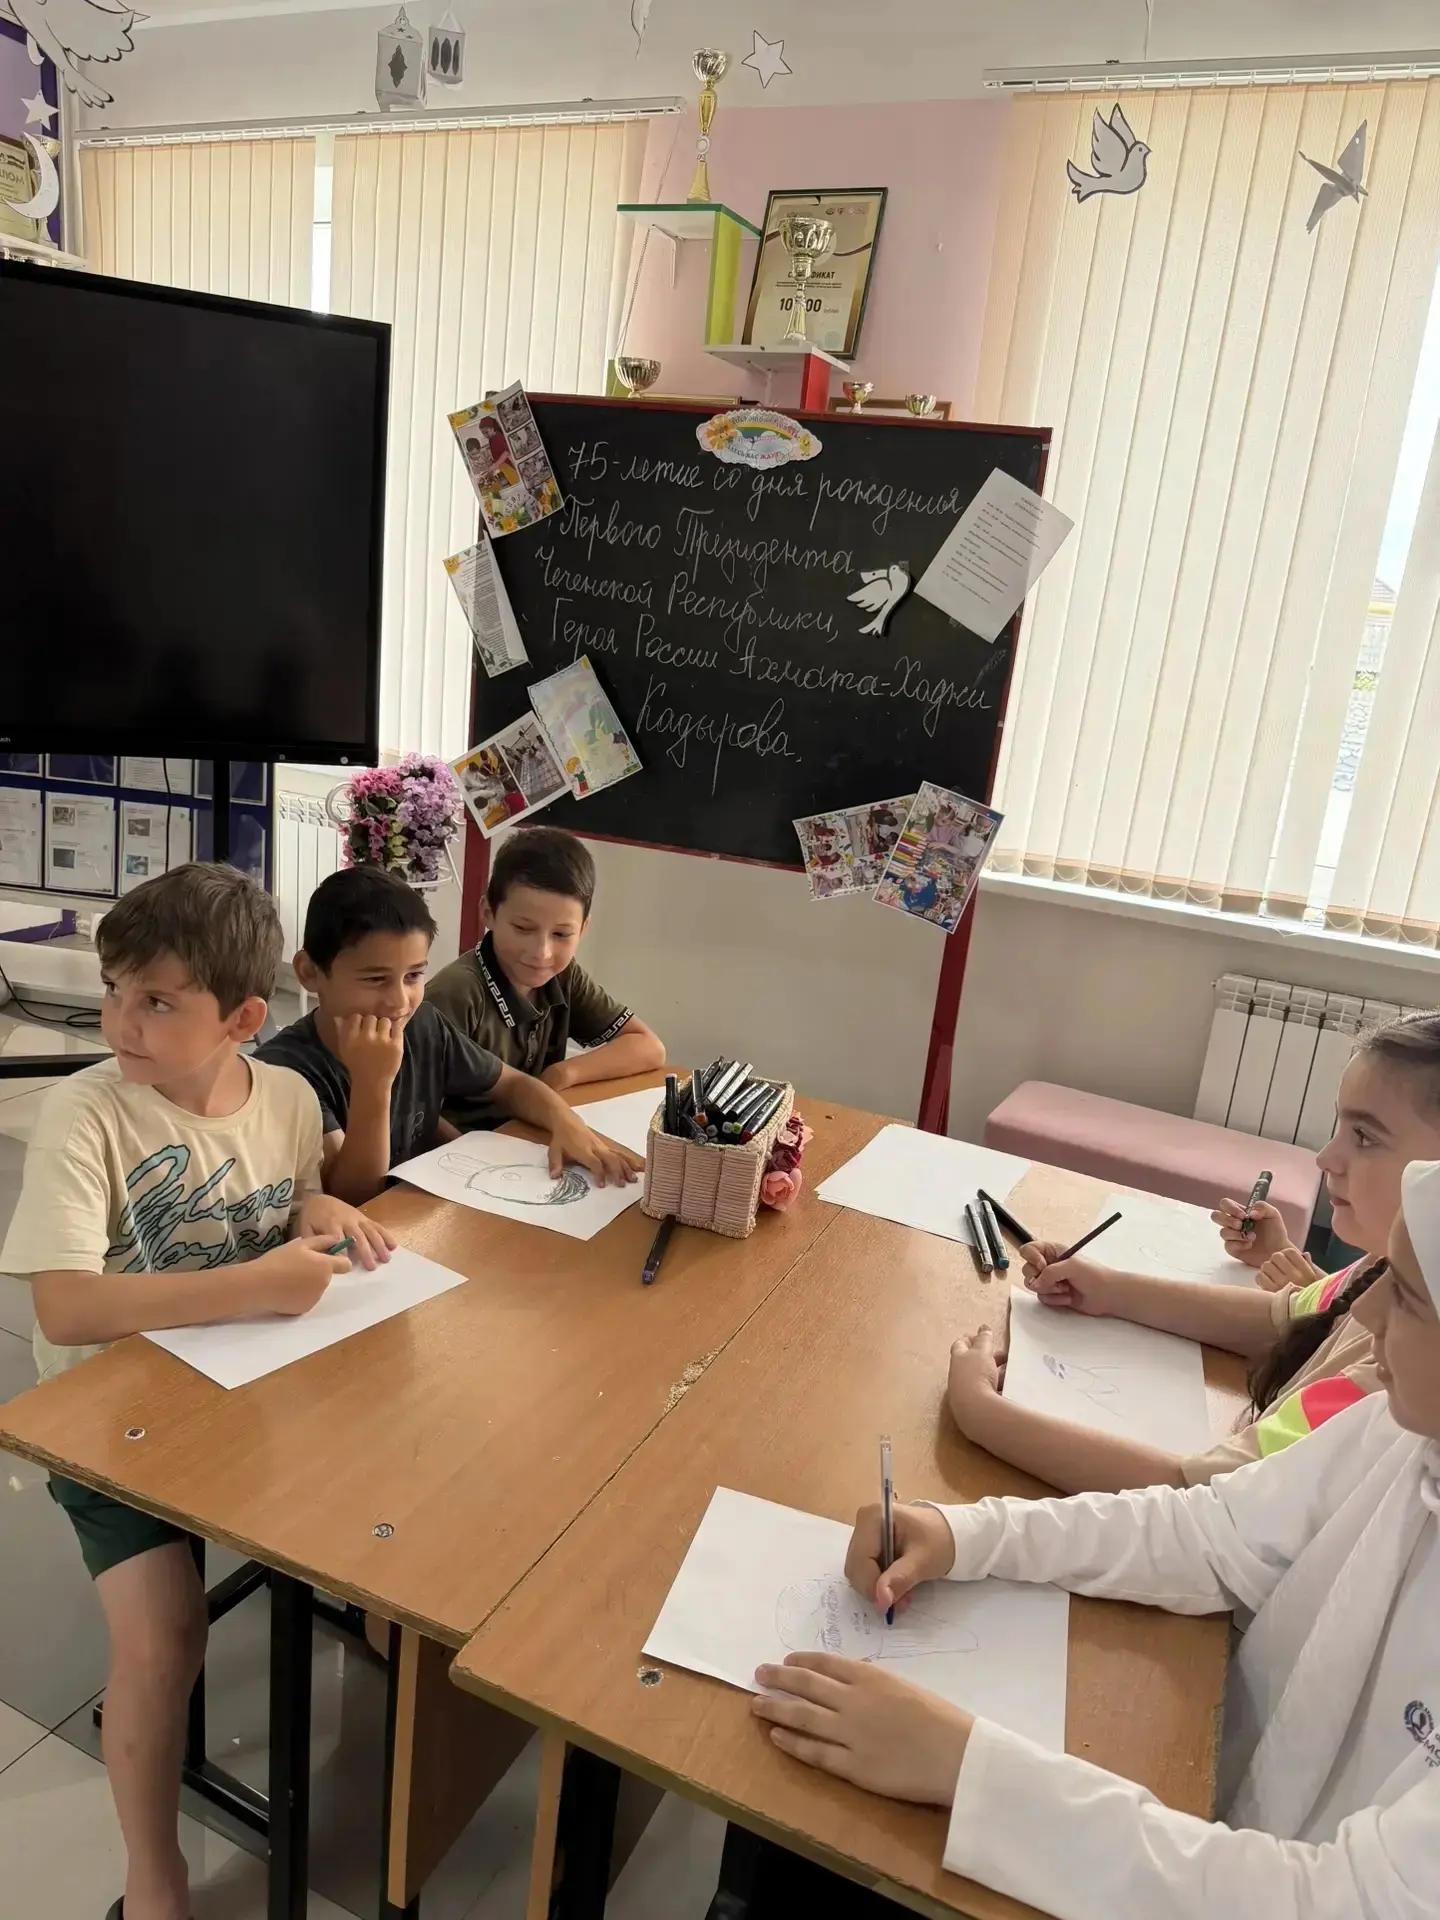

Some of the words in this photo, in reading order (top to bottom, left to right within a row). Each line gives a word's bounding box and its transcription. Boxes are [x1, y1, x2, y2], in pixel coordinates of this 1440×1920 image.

[787, 271, 836, 279] СФИКАТ
[568, 441, 705, 488] 75-летие
[713, 466, 742, 490] со
[747, 473, 808, 522] дня
[810, 472, 963, 536] рождения
[559, 494, 661, 562] Первого
[673, 507, 855, 592] Президента
[535, 545, 653, 608] Чеченской
[667, 571, 839, 654] Республики,
[552, 597, 620, 662] Героя
[635, 613, 718, 668] России
[729, 636, 993, 738] Ахмата-Хаджи
[635, 674, 802, 797] Кадырова.
